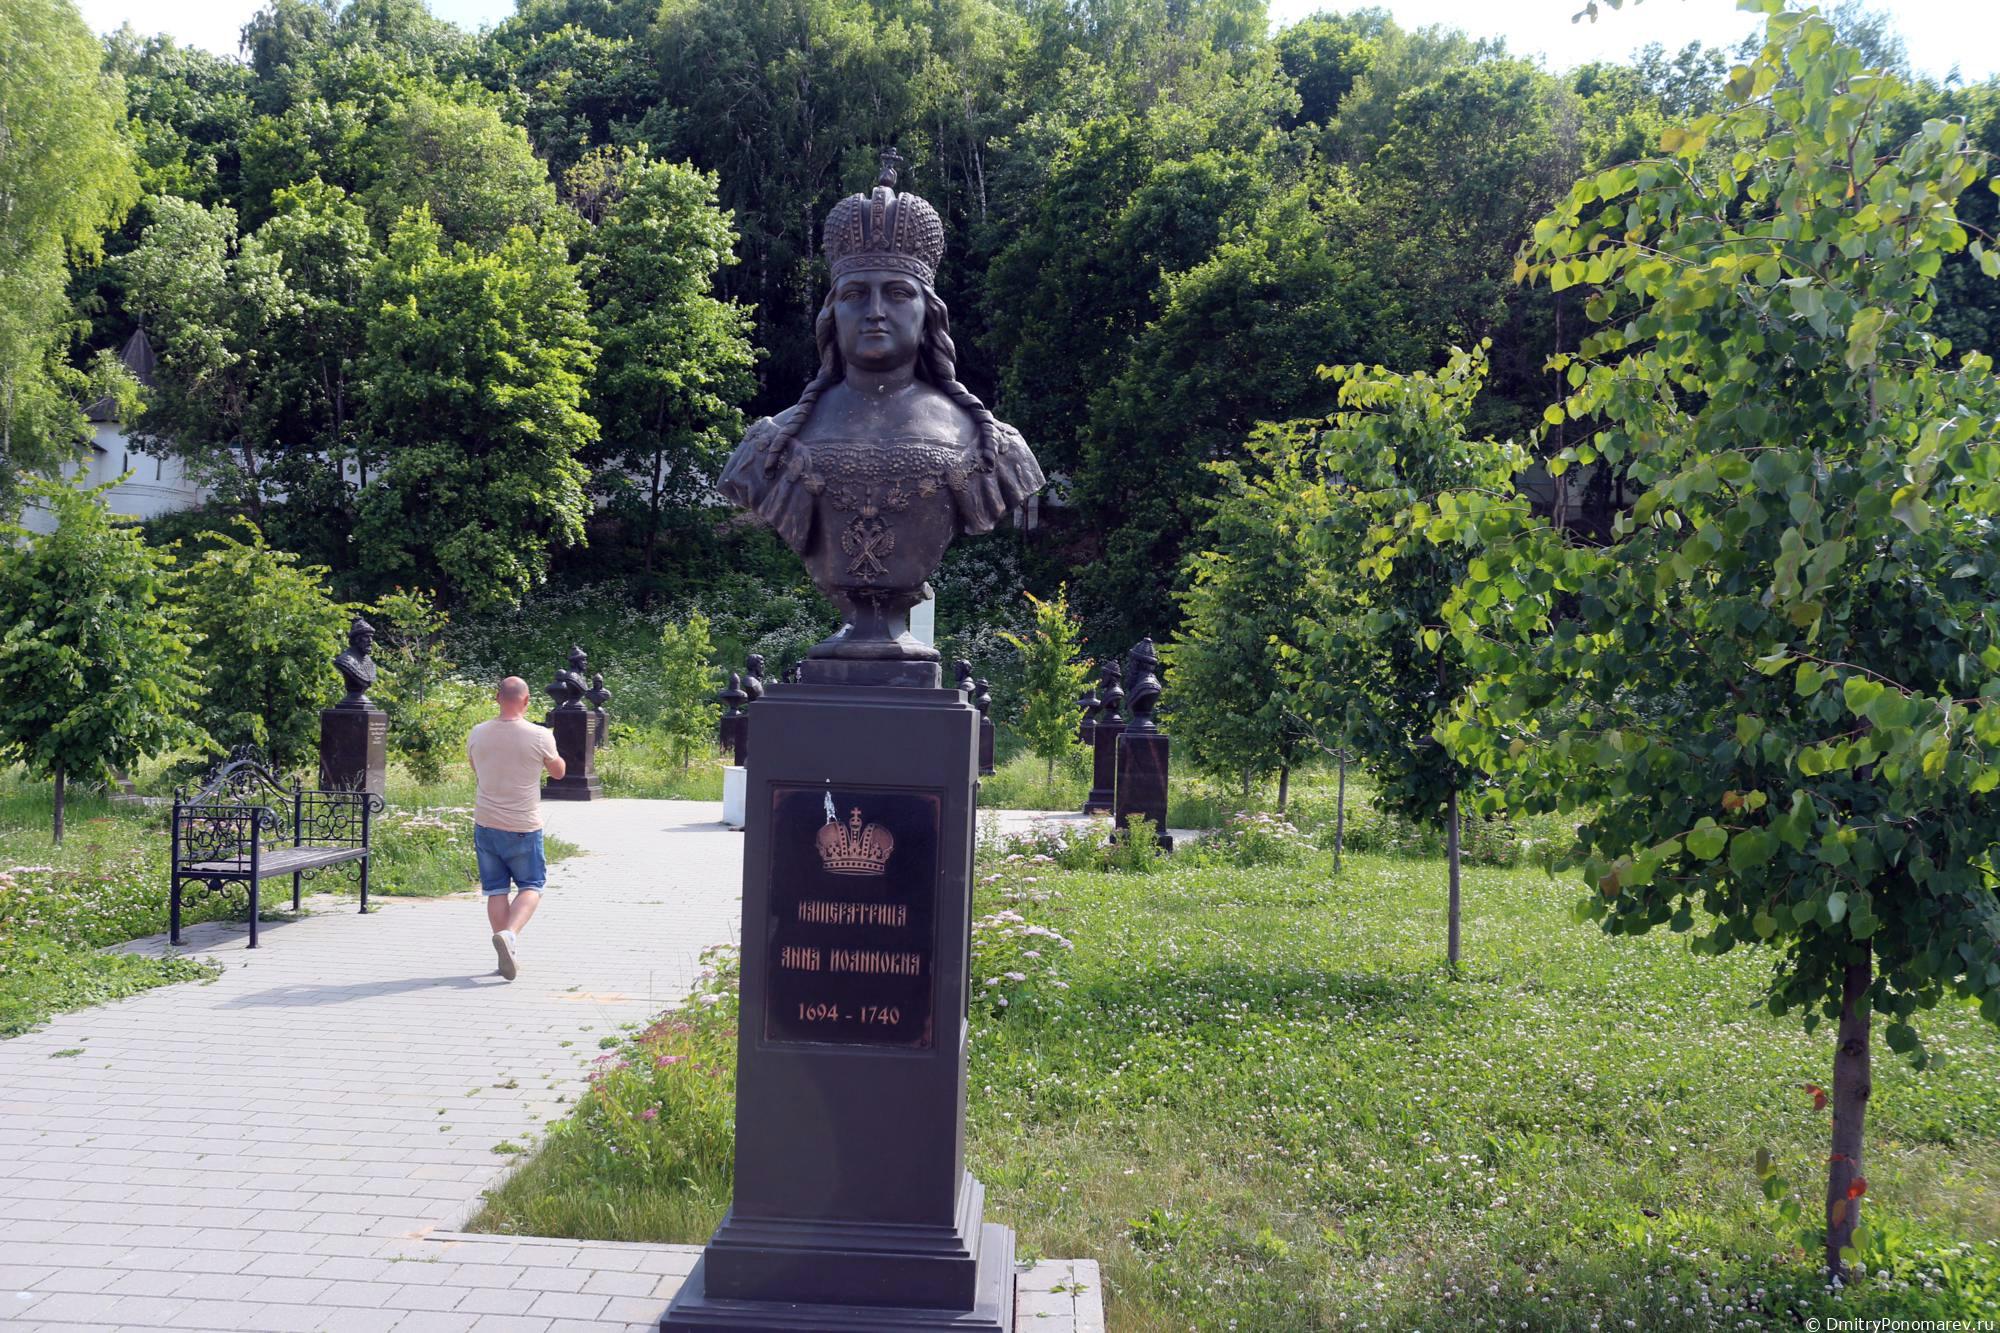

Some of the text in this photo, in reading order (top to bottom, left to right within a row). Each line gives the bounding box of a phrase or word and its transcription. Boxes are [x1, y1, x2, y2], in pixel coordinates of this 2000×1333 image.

[798, 900, 907, 927] ИМПЕРАТРИЦА
[781, 946, 920, 976] АННА ИОАННОВНА
[798, 1002, 839, 1021] 1694
[860, 1006, 900, 1025] 1740
